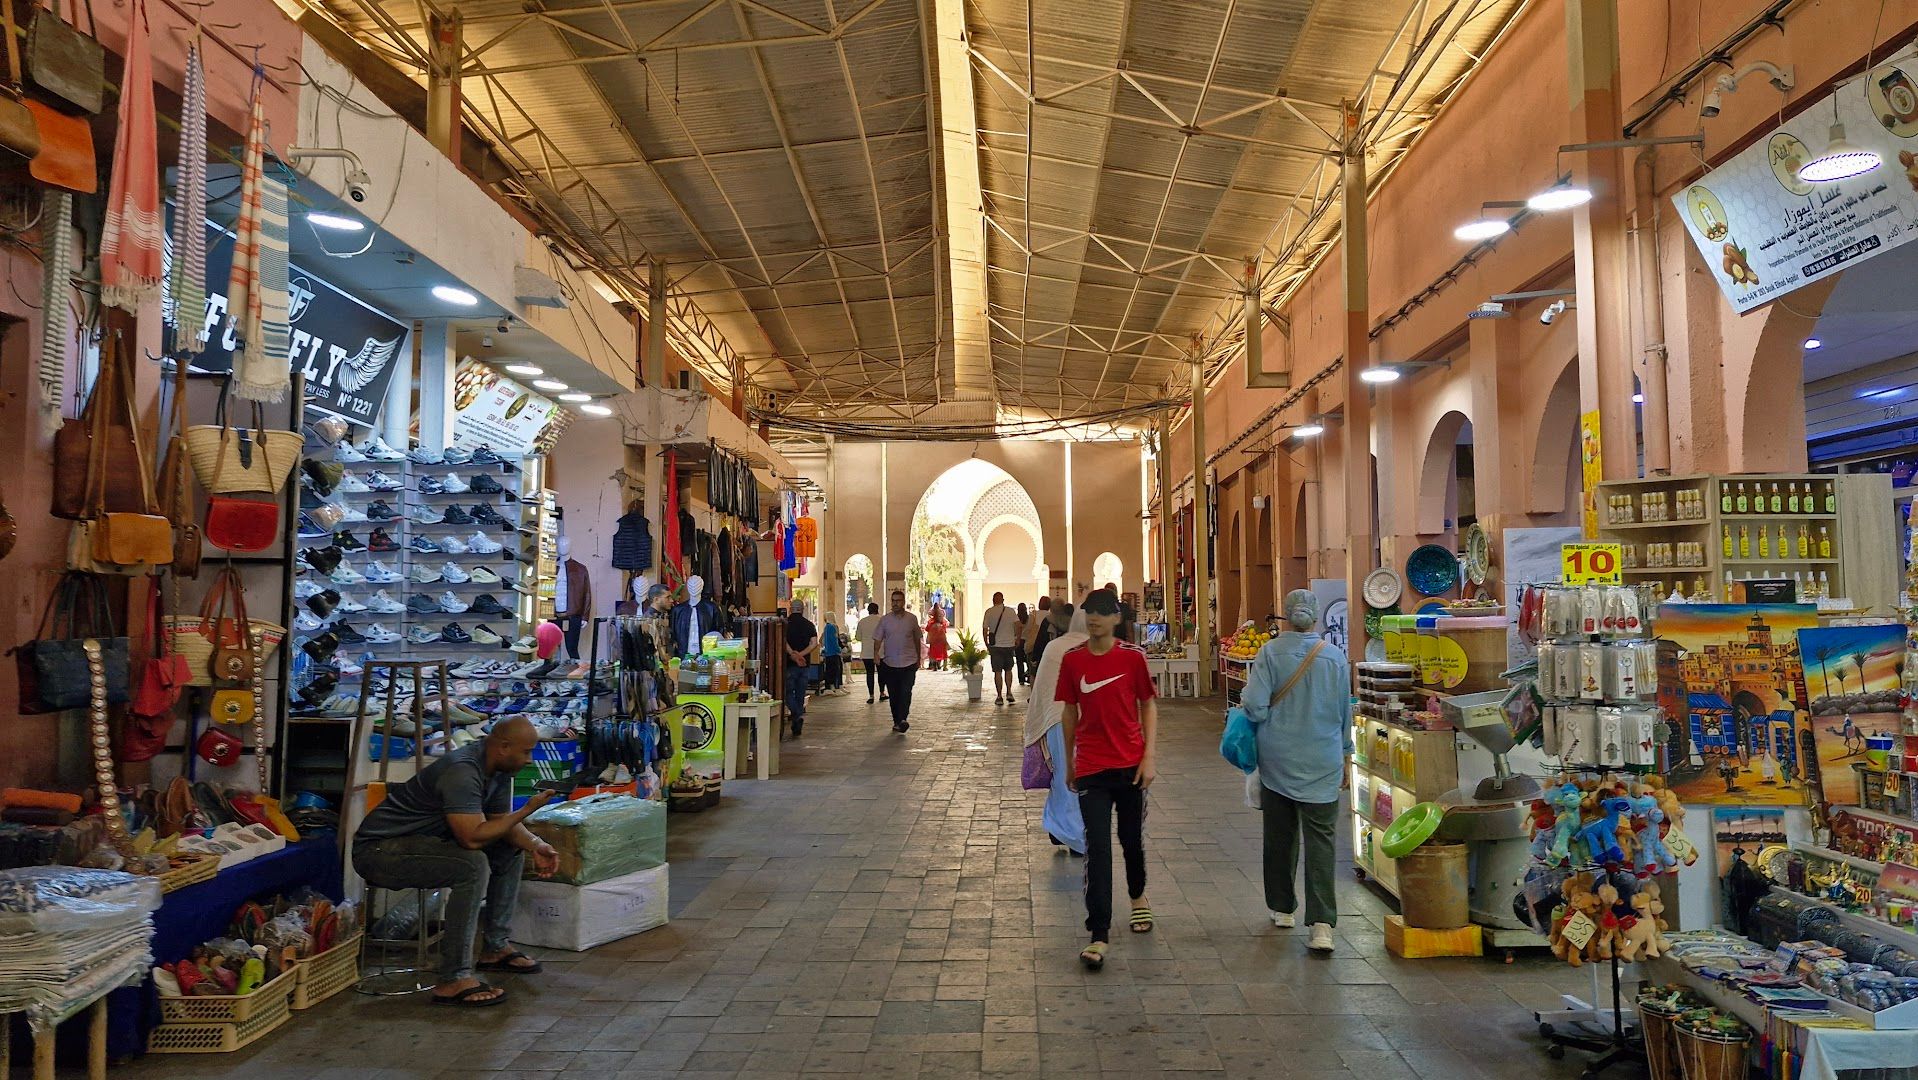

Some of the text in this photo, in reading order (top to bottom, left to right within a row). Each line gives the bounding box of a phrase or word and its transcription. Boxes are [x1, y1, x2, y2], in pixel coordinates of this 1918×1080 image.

[315, 387, 331, 399] LESS
[352, 397, 373, 417] 1221
[1566, 550, 1615, 574] 10
[1886, 772, 1899, 792] 50
[1666, 829, 1691, 851] 35
[1857, 888, 1871, 902] 20
[1571, 914, 1598, 936] 35
